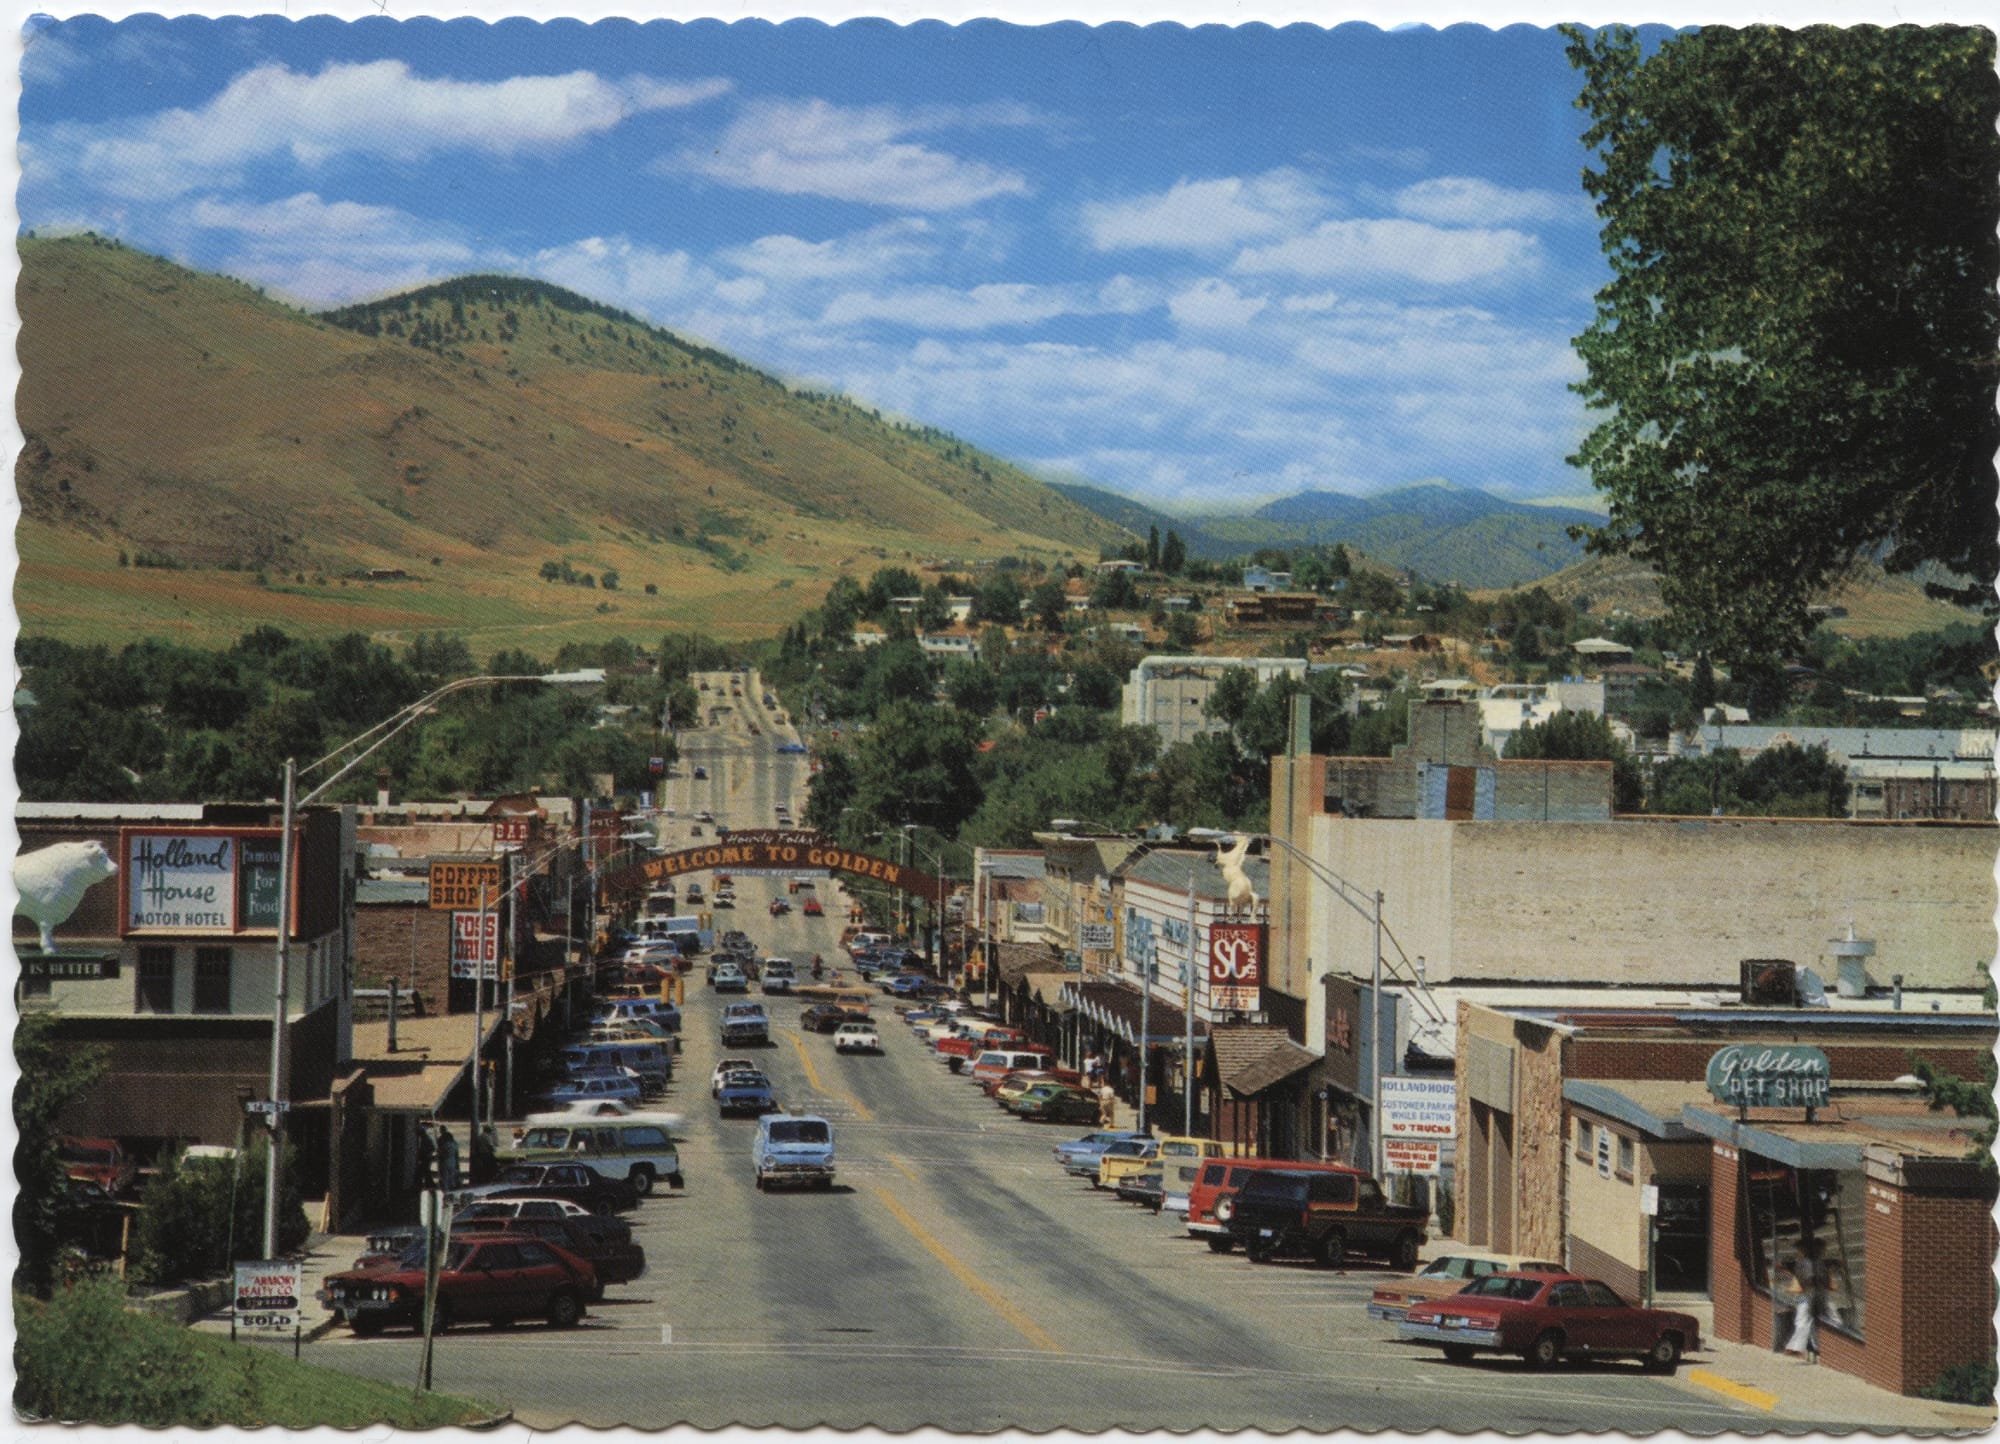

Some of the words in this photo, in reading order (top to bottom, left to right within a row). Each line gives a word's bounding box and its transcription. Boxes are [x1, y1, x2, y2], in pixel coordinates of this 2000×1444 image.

[496, 824, 529, 839] BAR
[132, 838, 229, 879] Holland
[241, 842, 281, 865] Famou
[643, 845, 754, 879] WELCOME
[766, 845, 797, 861] TO
[808, 849, 899, 882] GOLDEN
[433, 866, 498, 886] COFFEE
[140, 868, 217, 910] House
[433, 887, 479, 904] SHOP
[133, 912, 181, 926] MOTOR
[184, 912, 226, 926] HOTEL
[1213, 930, 1249, 940] STEVE'S
[1213, 939, 1249, 979] SC
[1247, 940, 1257, 979] CORNER
[1718, 1048, 1823, 1087] Golden
[1428, 1084, 1457, 1095] HOUS
[1730, 1078, 1767, 1099] PET
[1776, 1078, 1827, 1099] SHOP
[1383, 1101, 1425, 1111] CUSTOMER
[1427, 1103, 1457, 1112] PARKIN
[1391, 1112, 1417, 1121] WHILE
[1420, 1112, 1452, 1122] EATING
[1392, 1123, 1406, 1132] NO
[1408, 1124, 1452, 1134] TRUCKS
[243, 1313, 292, 1326] SOLD
